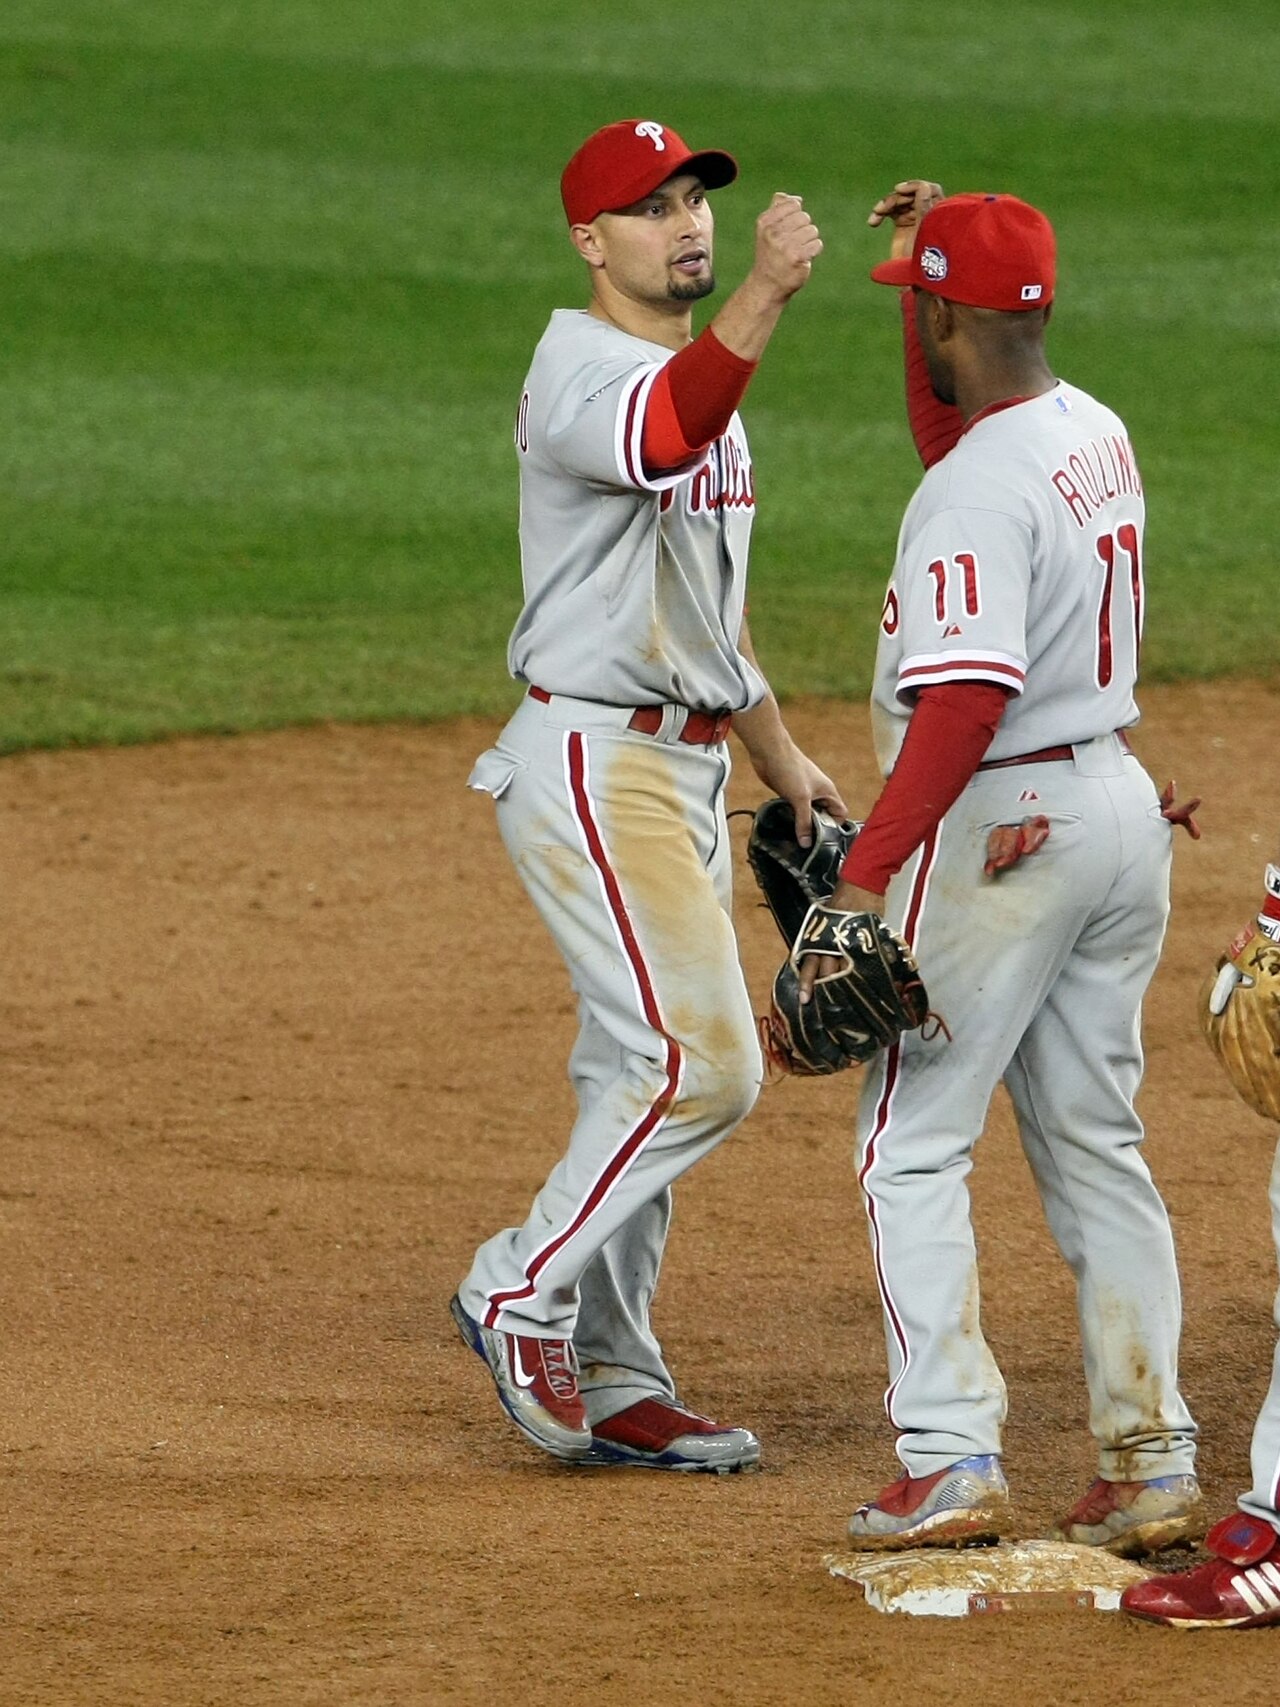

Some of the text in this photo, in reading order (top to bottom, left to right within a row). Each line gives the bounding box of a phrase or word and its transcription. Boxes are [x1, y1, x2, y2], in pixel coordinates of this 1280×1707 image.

[635, 121, 665, 151] P
[927, 550, 982, 625] 11
[1095, 519, 1144, 690] 11
